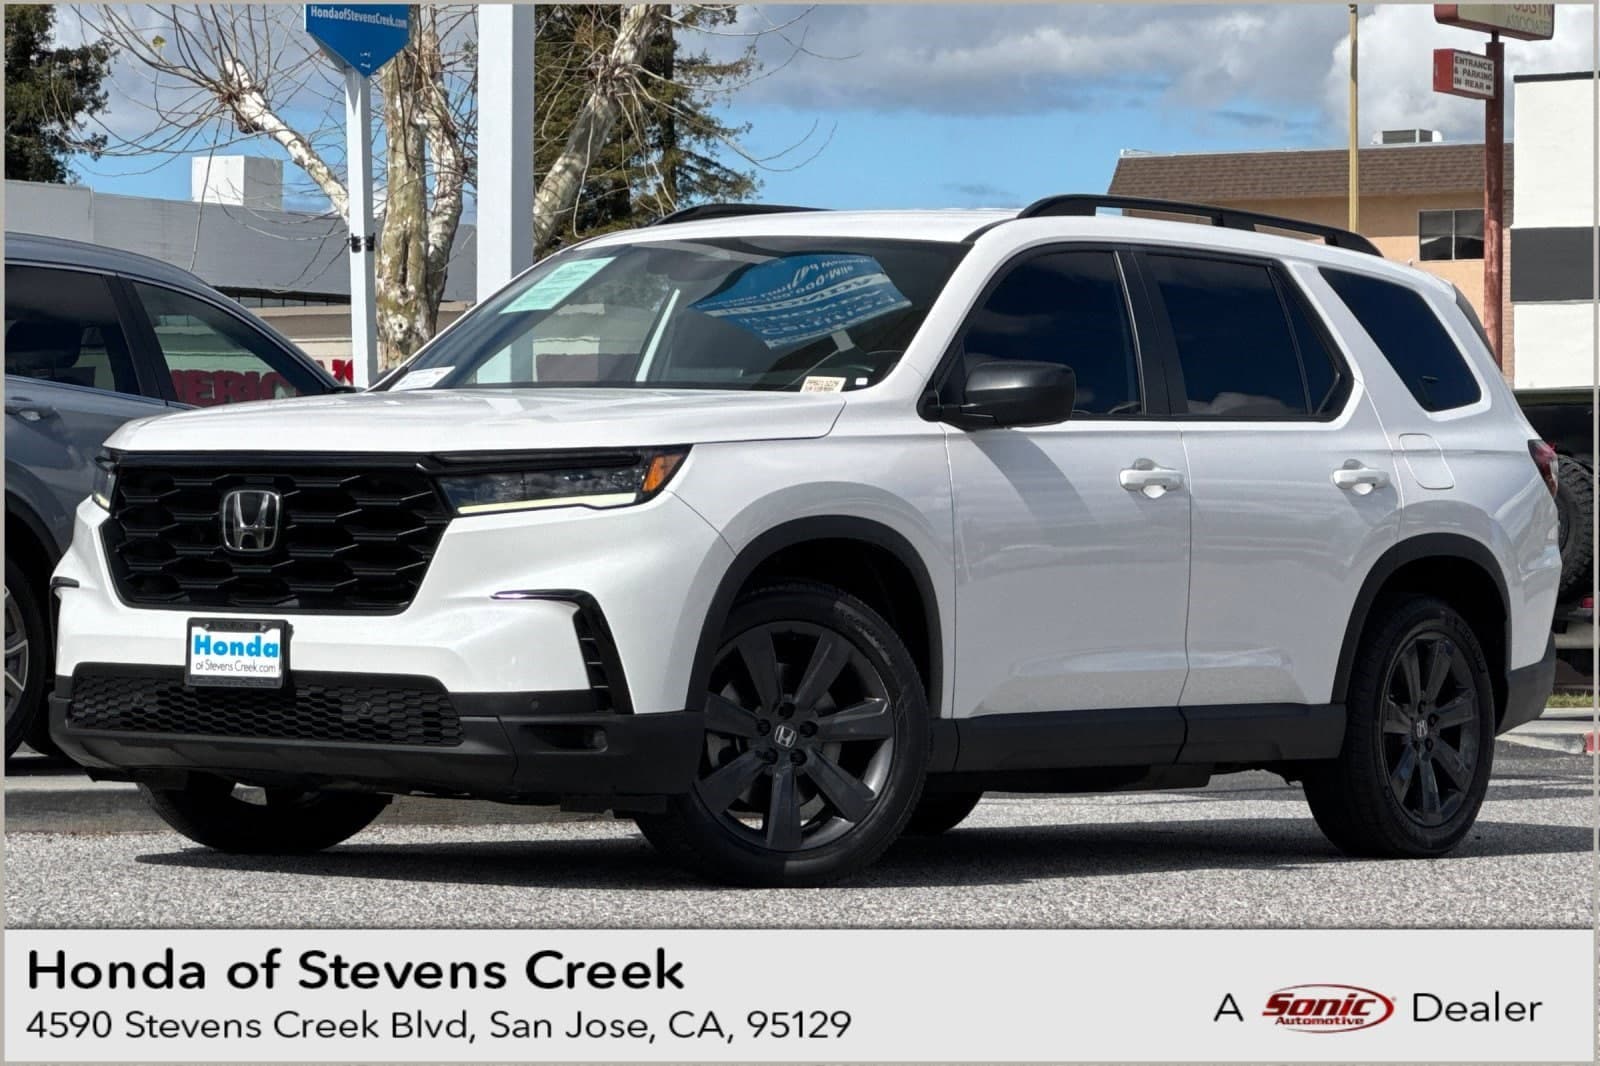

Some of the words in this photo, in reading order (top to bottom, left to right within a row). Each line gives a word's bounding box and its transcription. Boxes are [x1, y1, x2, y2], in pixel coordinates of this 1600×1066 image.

[1454, 55, 1493, 71] ENTRANCE
[1462, 68, 1493, 81] PARKING
[1454, 77, 1462, 85] IN
[1465, 79, 1485, 90] REAR
[194, 634, 279, 658] Honda
[196, 661, 205, 671] of
[204, 659, 234, 672] Stevens
[234, 660, 276, 674] Creek.com
